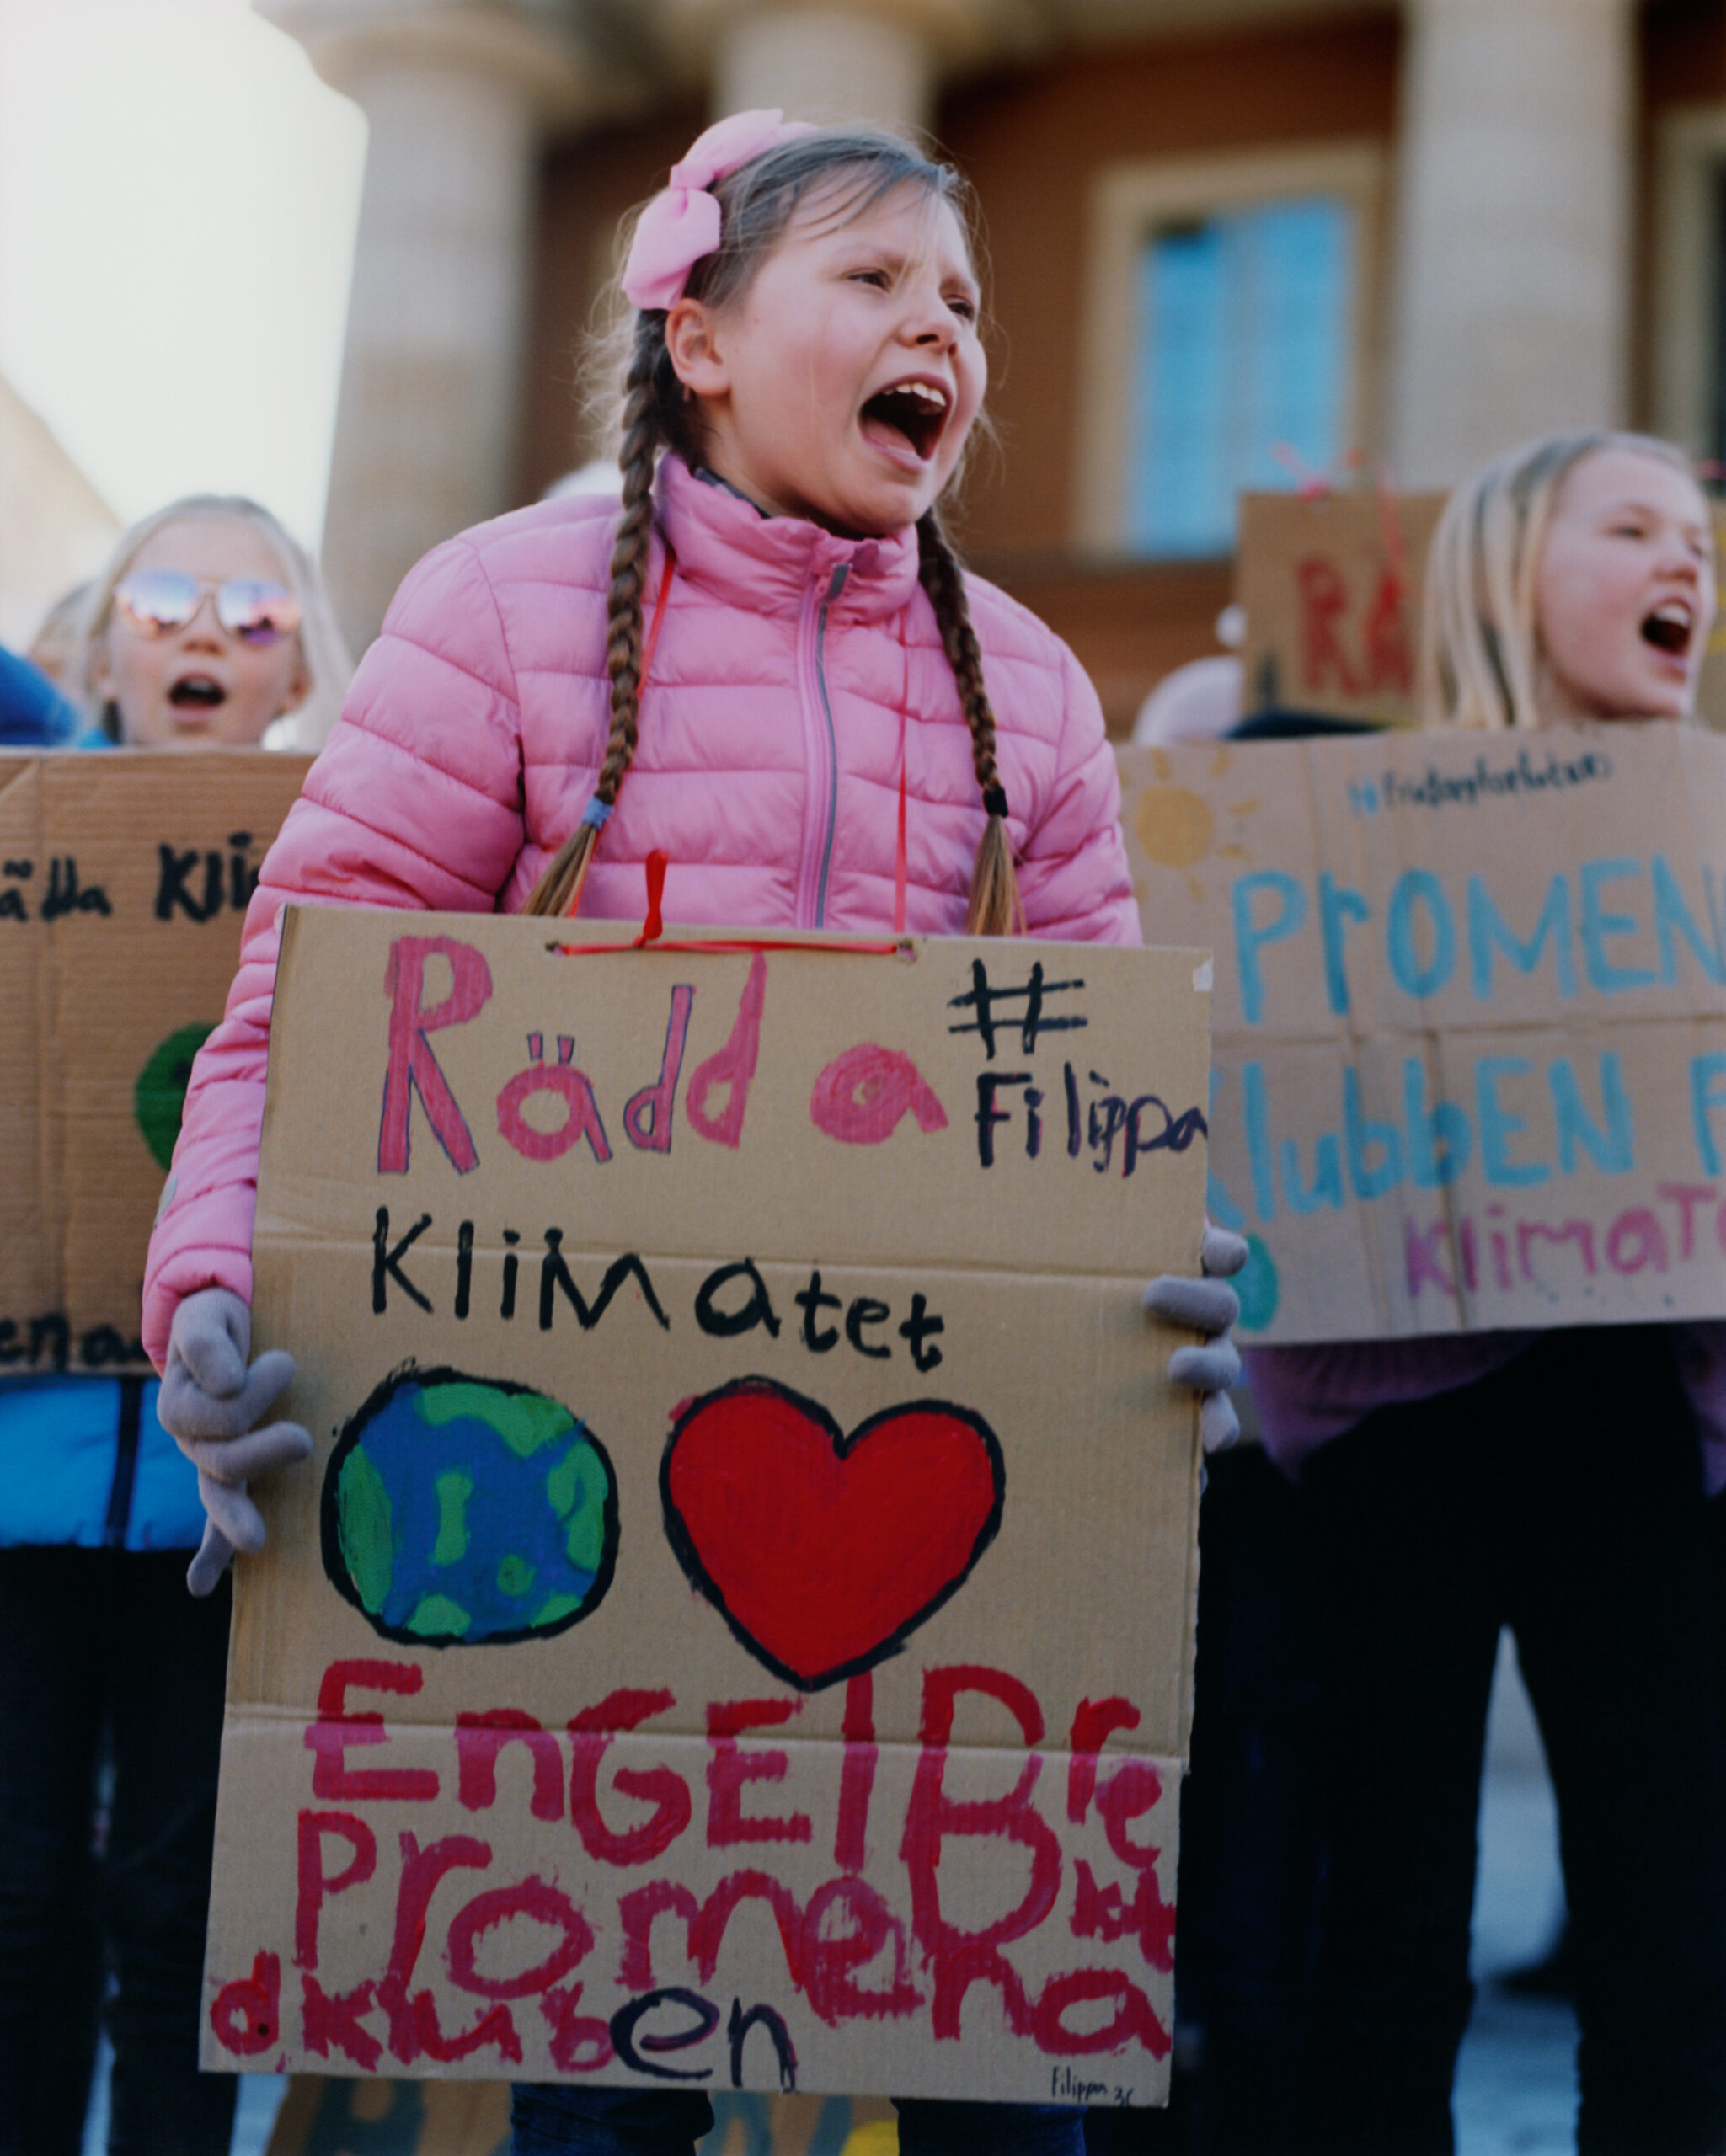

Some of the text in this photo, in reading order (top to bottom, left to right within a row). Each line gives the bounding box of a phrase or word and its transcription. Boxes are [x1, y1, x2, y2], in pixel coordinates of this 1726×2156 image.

[155, 831, 261, 921] Kli
[377, 935, 948, 1176] Rädda
[974, 1060, 1208, 1178] Filippa
